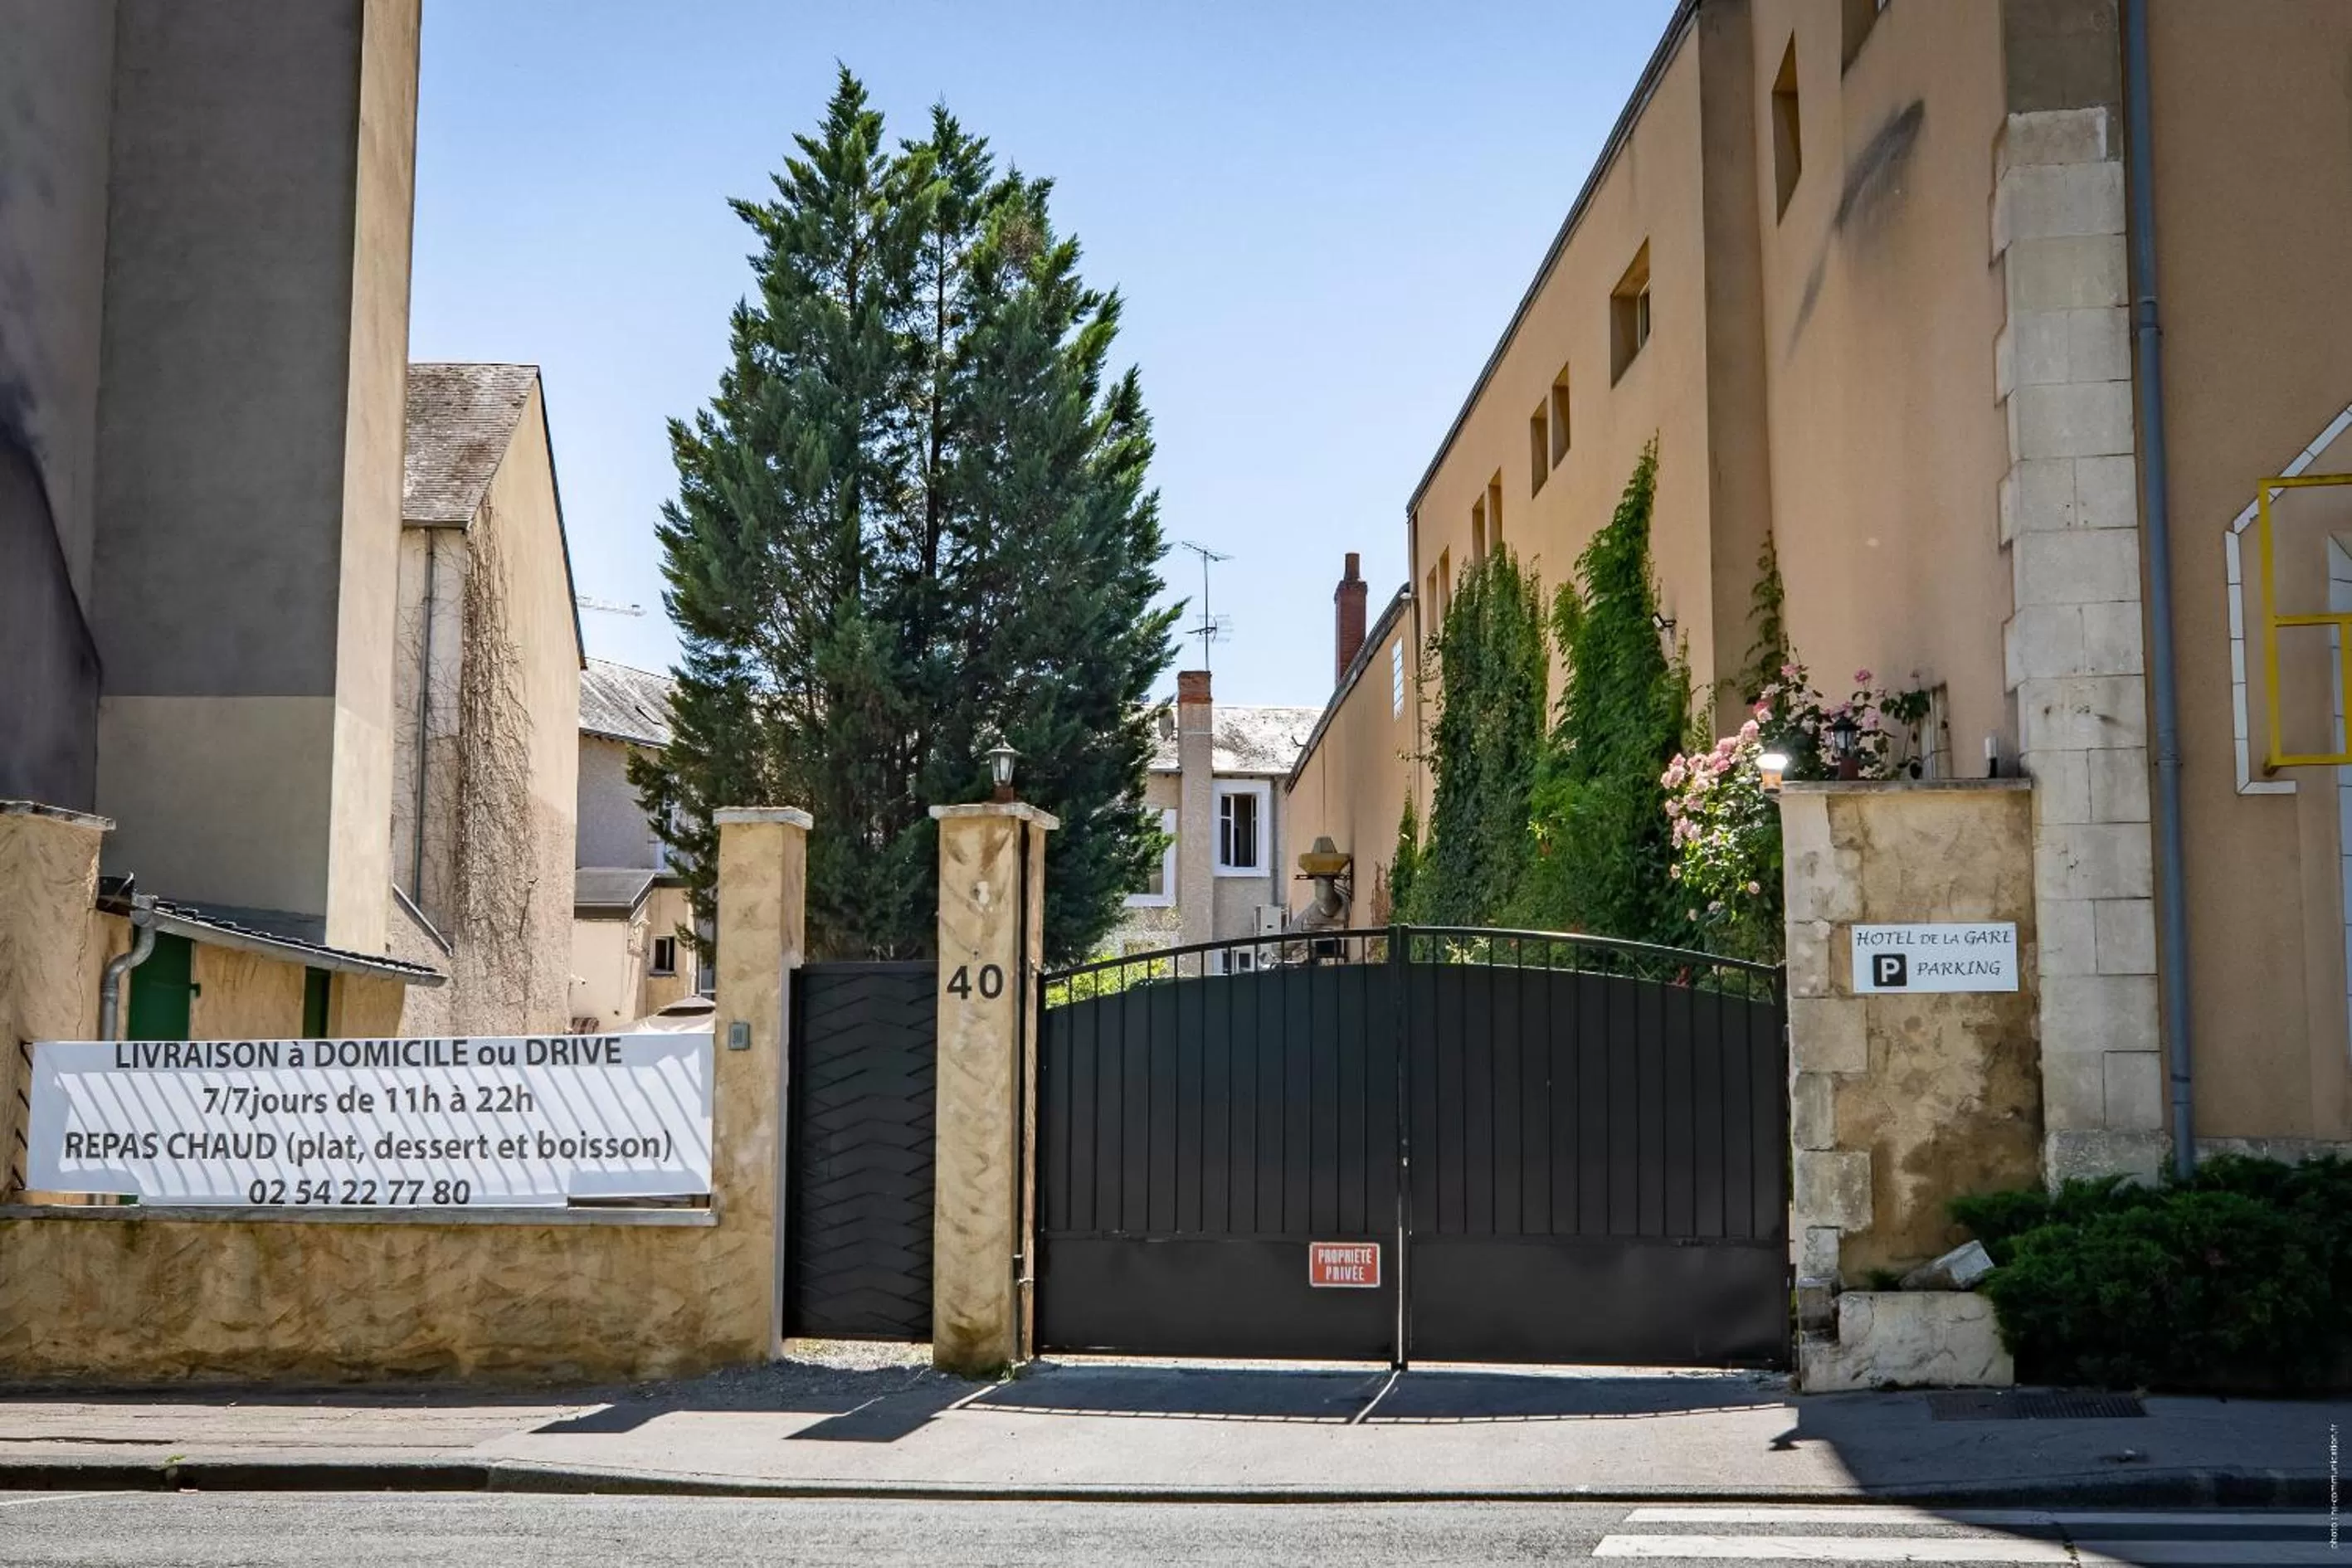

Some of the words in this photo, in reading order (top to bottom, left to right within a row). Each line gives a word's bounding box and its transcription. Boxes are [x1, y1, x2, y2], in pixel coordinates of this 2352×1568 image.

[1857, 930, 1915, 946] HOTEL
[1920, 933, 1938, 944] DE
[1944, 933, 1959, 944] LA
[1964, 930, 2012, 945] GARE
[947, 964, 1003, 1000] 40
[1881, 957, 1900, 982] P
[1916, 960, 2001, 976] PARKING
[115, 1041, 279, 1069] LIVRAISON
[288, 1041, 304, 1068] à
[314, 1039, 469, 1067] DOMICILE
[477, 1045, 516, 1065] ou
[527, 1037, 622, 1064] DRIVE
[337, 1085, 375, 1113] de
[387, 1083, 441, 1113] 11h
[449, 1084, 467, 1113] à
[475, 1083, 534, 1113] 22h
[65, 1132, 158, 1160] REPAS
[167, 1132, 277, 1159] CHAUD
[286, 1131, 365, 1165] (plat,
[374, 1132, 489, 1160] dessert
[497, 1133, 528, 1159] et
[537, 1128, 673, 1161] boisson)
[250, 1180, 285, 1205] 02
[295, 1180, 332, 1205] 54
[341, 1179, 377, 1205] 22
[388, 1179, 424, 1204] 77
[431, 1179, 471, 1205] 80
